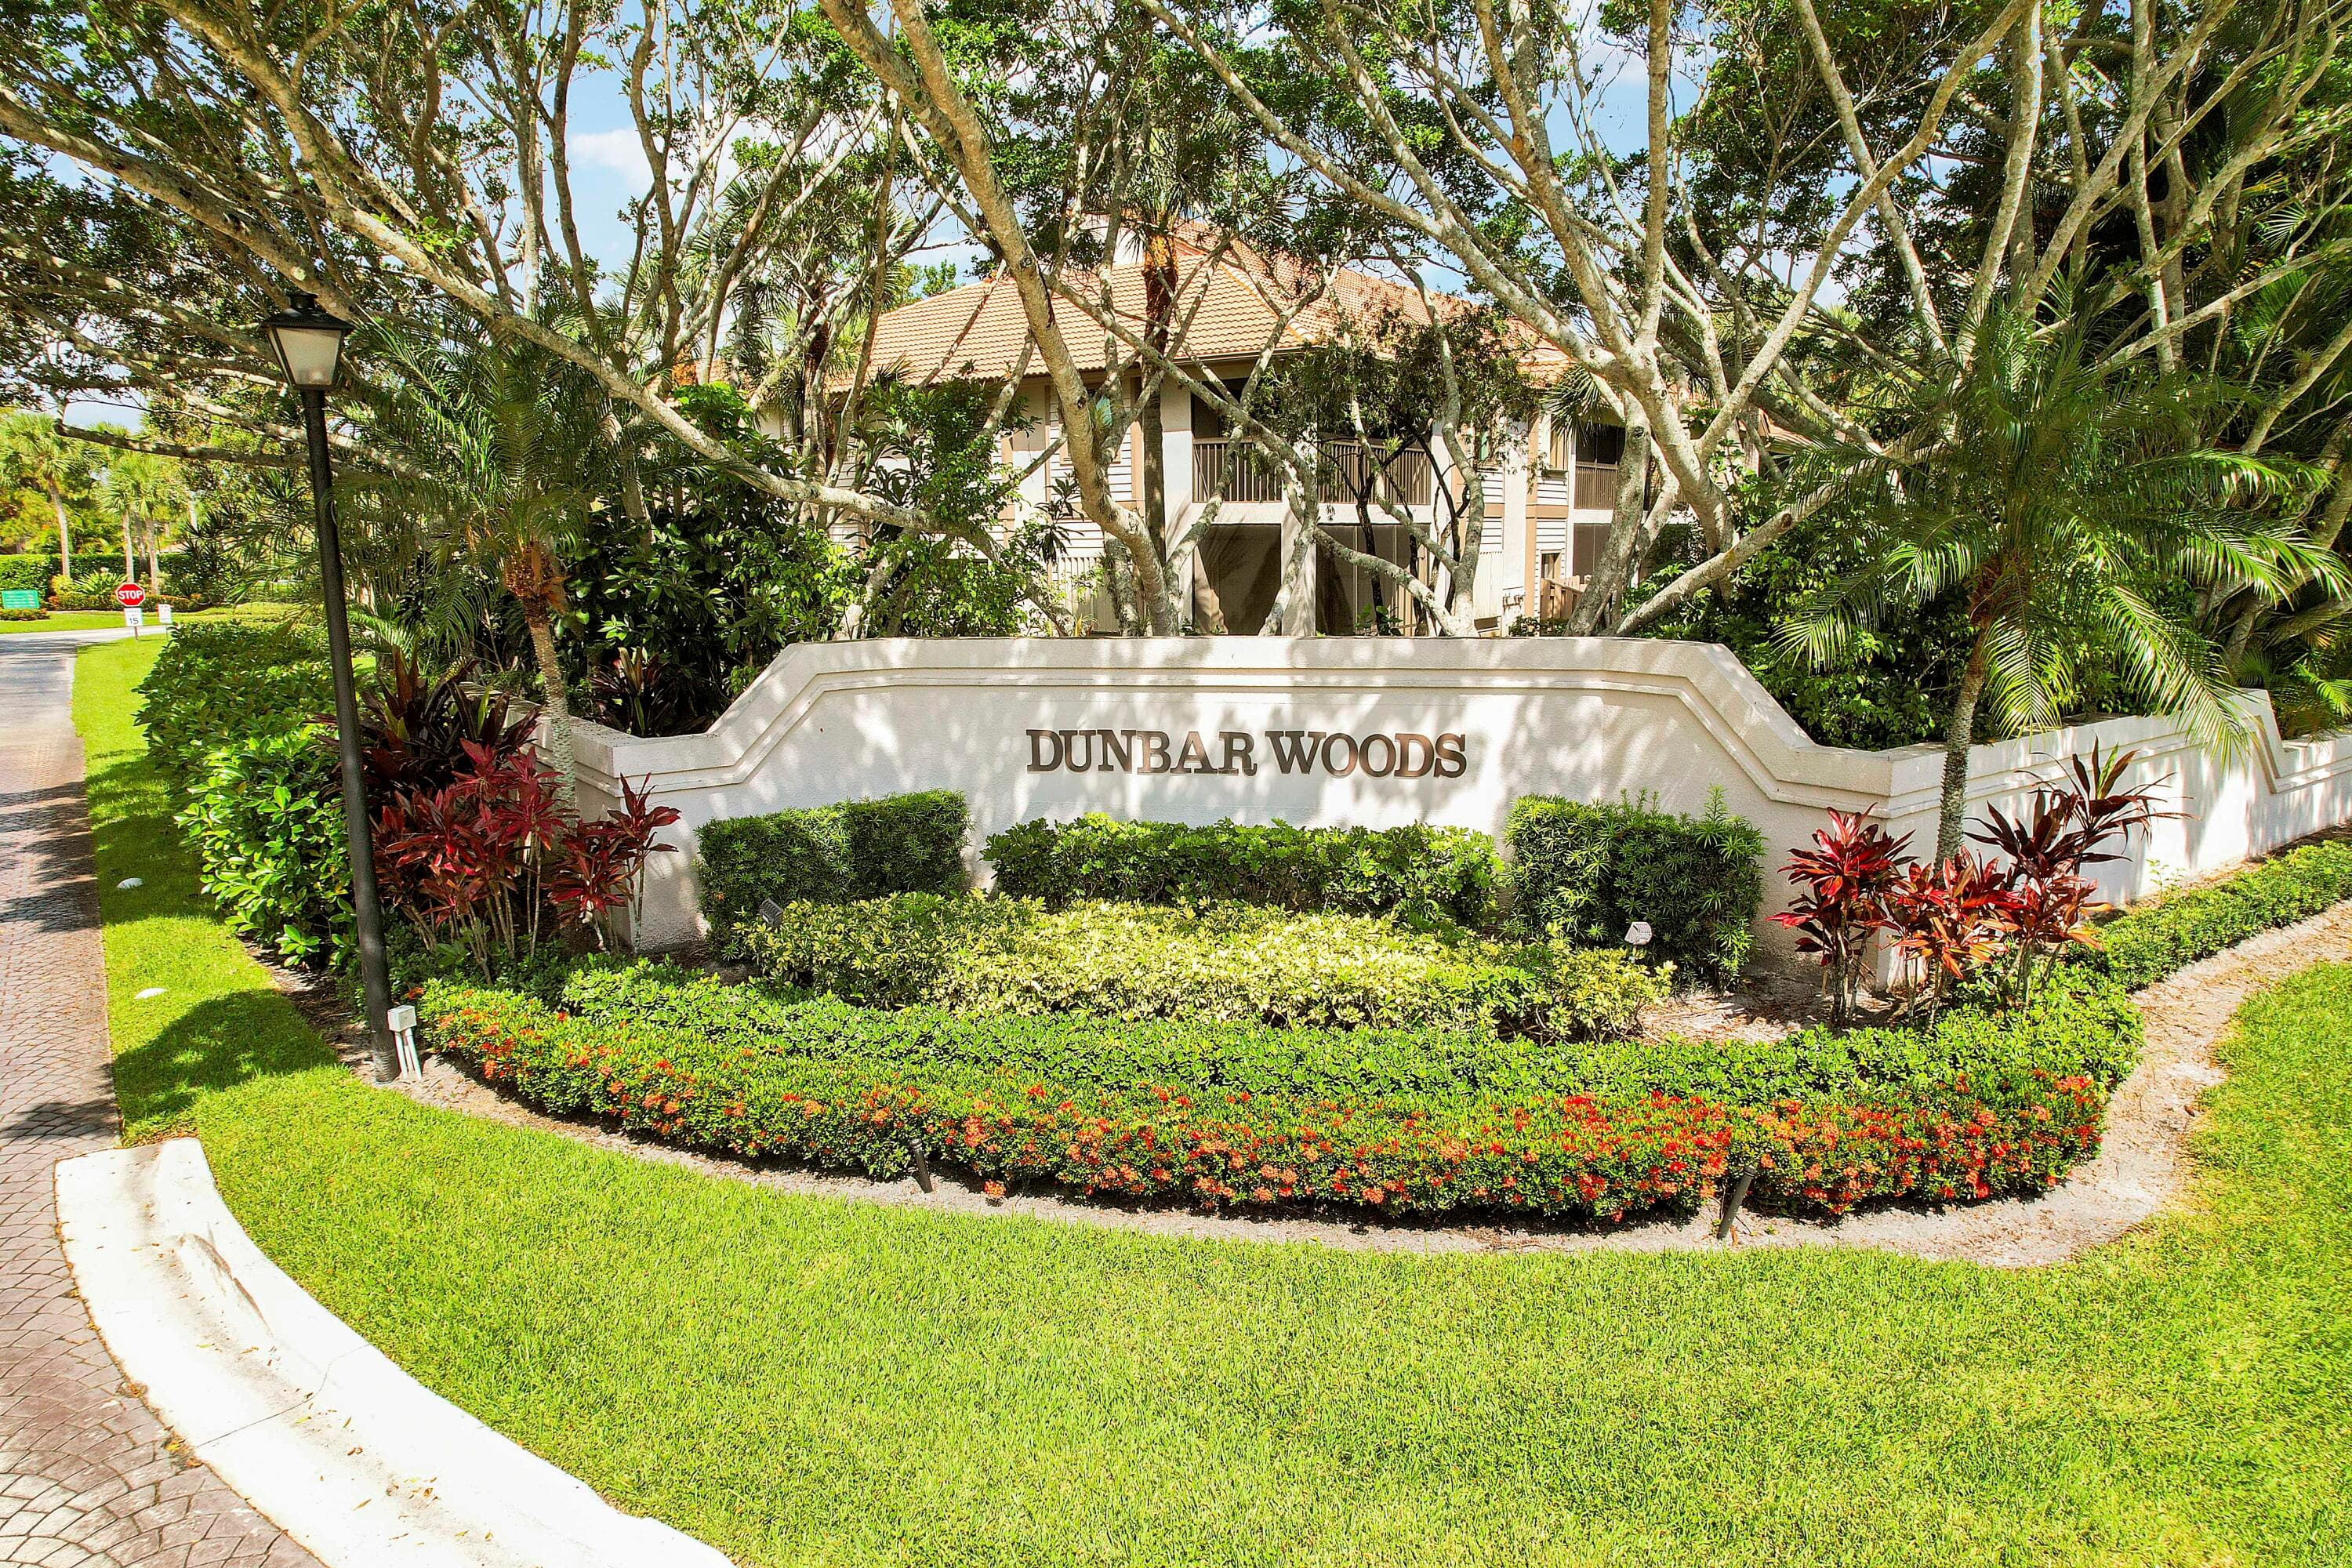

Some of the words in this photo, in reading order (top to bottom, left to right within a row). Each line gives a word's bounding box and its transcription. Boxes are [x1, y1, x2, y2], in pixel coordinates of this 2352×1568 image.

[118, 590, 142, 599] STOP
[1026, 729, 1257, 776] DUNBAR
[1265, 730, 1467, 778] WOODS
